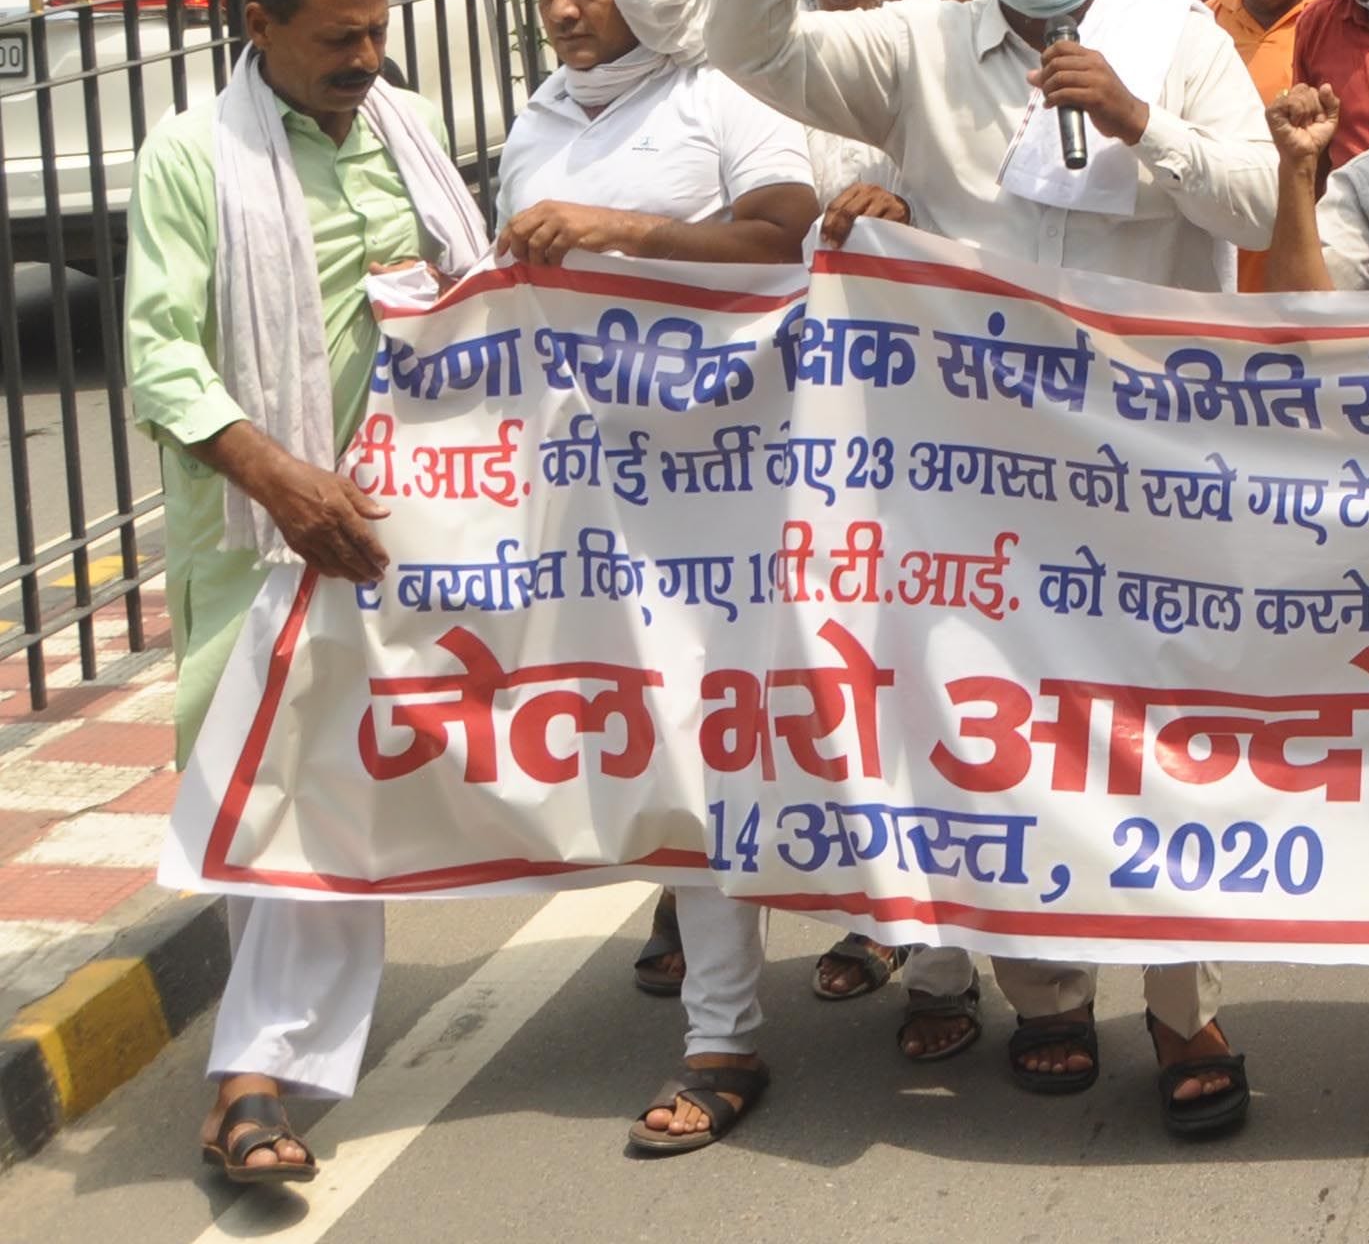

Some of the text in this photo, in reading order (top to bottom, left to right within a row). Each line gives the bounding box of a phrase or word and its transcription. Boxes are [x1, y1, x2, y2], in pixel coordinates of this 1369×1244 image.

[933, 310, 1095, 413] संघर्ष
[1111, 347, 1325, 429] समिति
[539, 414, 601, 487] की
[660, 425, 760, 494] भर्ती
[846, 436, 894, 489] 23
[909, 440, 1056, 502] अगस्त
[1067, 443, 1130, 513] को
[1140, 451, 1237, 523] रखे
[1248, 475, 1328, 546] गए
[656, 555, 739, 623] गए
[1039, 544, 1106, 618] को
[1117, 566, 1242, 634] बहाल
[358, 624, 664, 784] जेल
[698, 618, 895, 782] भरो
[706, 799, 760, 873] 14
[1109, 817, 1325, 895] 2020
